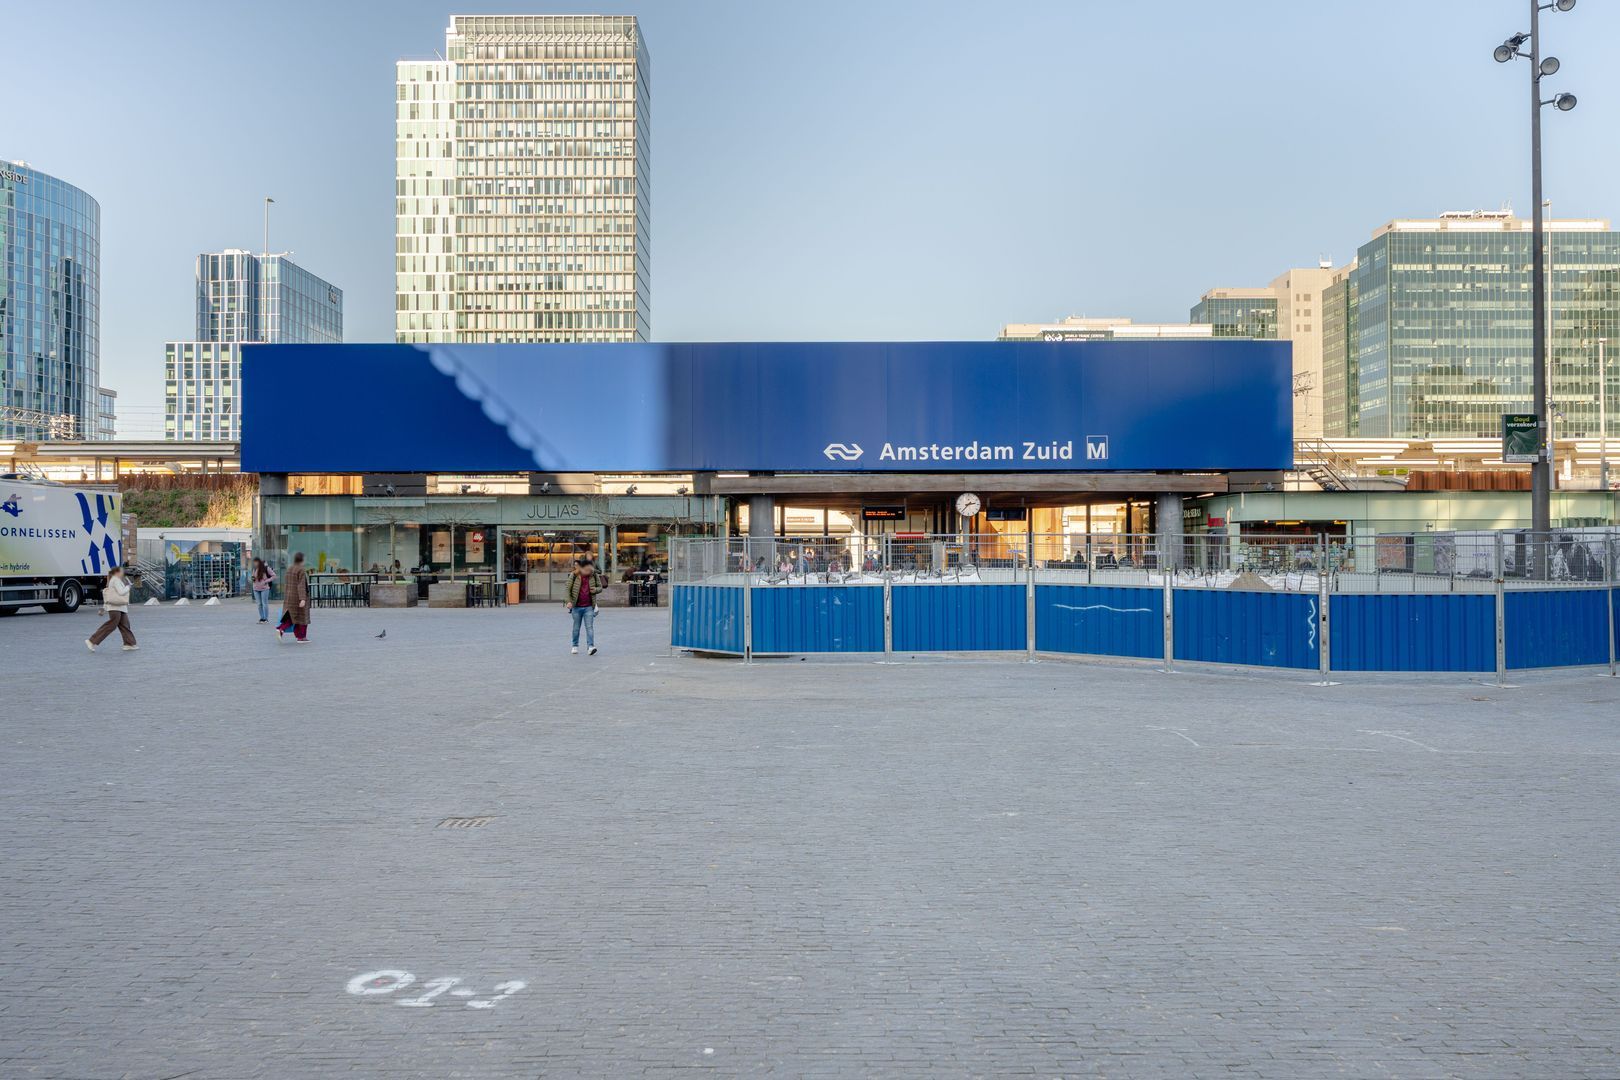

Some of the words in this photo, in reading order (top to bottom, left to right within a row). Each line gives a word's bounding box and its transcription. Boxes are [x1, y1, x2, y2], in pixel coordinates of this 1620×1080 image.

[879, 441, 1014, 461] Amsterdam
[1022, 441, 1073, 461] Zuid
[527, 504, 579, 519] JULIA'S
[9, 562, 31, 573] hybride
